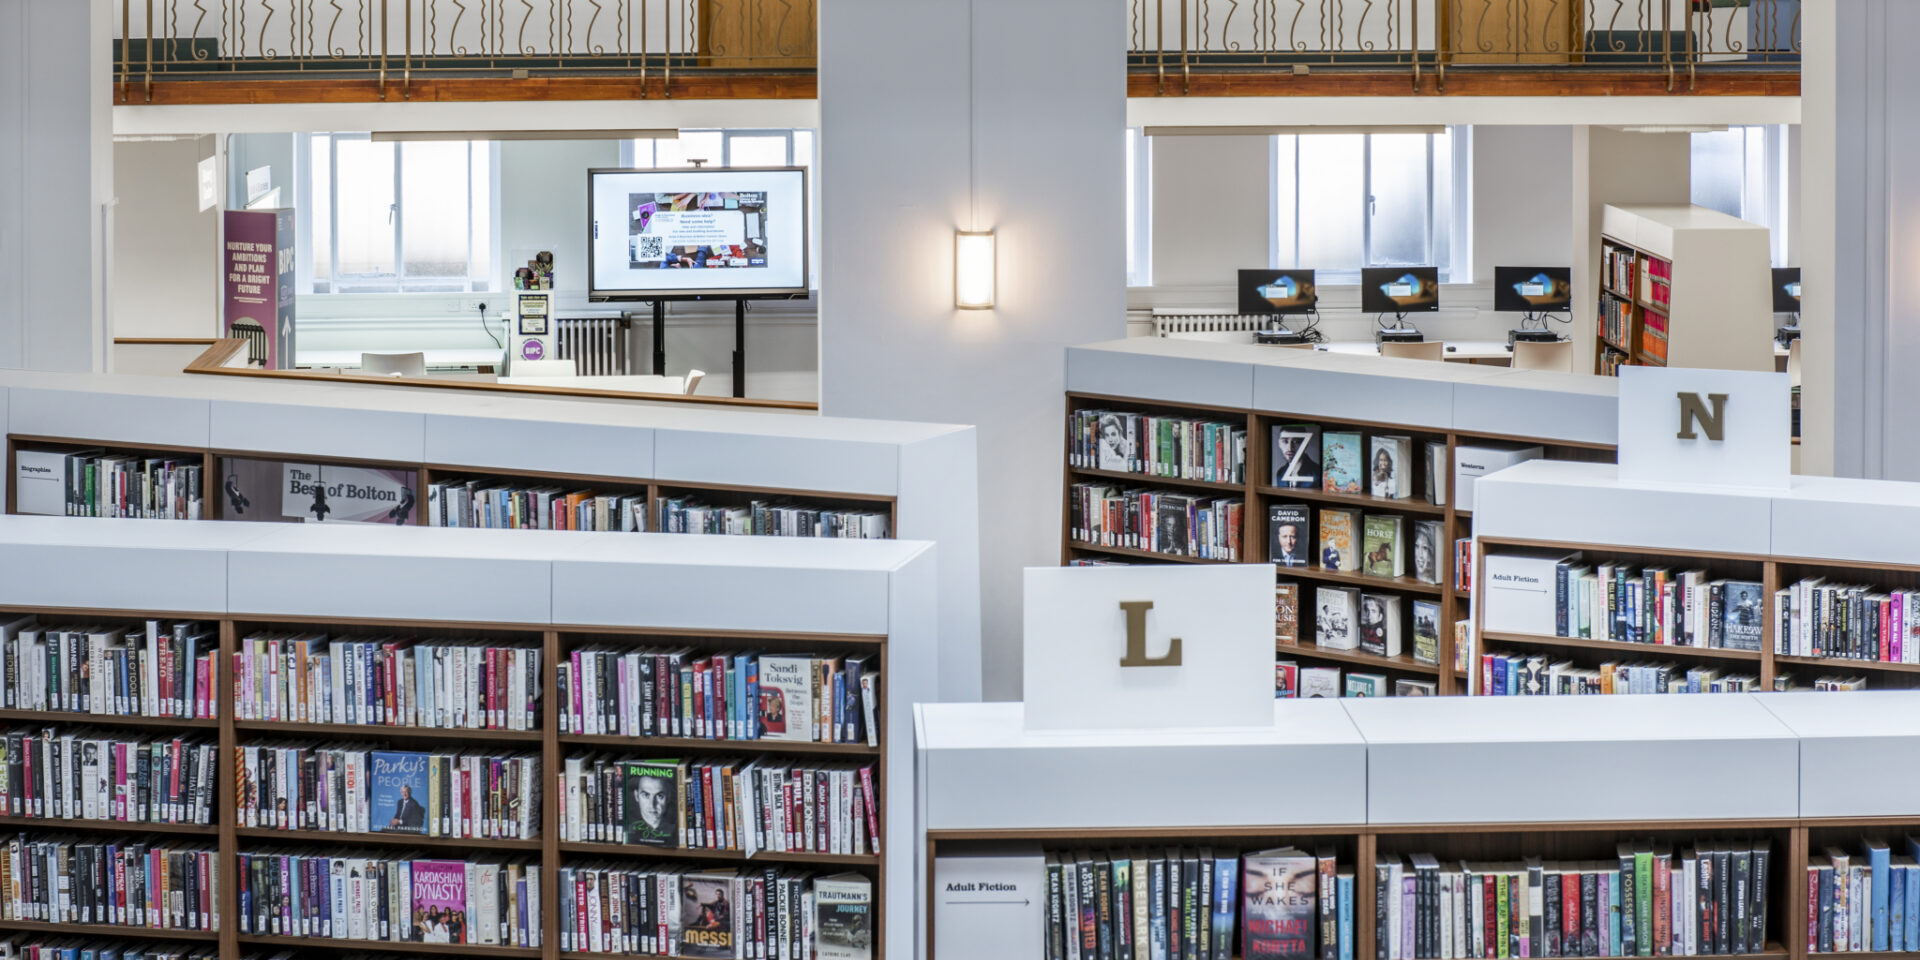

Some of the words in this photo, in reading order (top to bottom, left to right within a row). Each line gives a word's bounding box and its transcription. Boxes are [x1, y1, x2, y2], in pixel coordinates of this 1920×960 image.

[227, 242, 254, 252] NURTURE
[256, 243, 272, 253] YOUR
[232, 252, 266, 263] AMBITIONS
[278, 248, 294, 276] BIPC
[234, 263, 247, 274] AND
[248, 263, 264, 274] PLAN
[229, 273, 240, 284] FOR
[241, 274, 246, 284] A
[248, 274, 270, 285] BRIGHT
[238, 284, 261, 294] FUTURE
[525, 347, 540, 355] BIPC
[1676, 392, 1728, 440] N
[20, 464, 51, 474] Biographies
[290, 469, 312, 480] The
[290, 480, 325, 499] Bes
[328, 484, 344, 496] of
[346, 484, 396, 502] Bolton
[1366, 528, 1394, 539] HORSE
[1492, 573, 1512, 582] Adult
[1514, 575, 1540, 584] Fiction
[1120, 601, 1182, 667] L
[1726, 622, 1762, 634] HARROW
[288, 657, 295, 670] CJ
[770, 662, 798, 674] Sandi
[129, 662, 137, 697] O'TOOLE
[764, 673, 803, 686] Toksvig
[373, 756, 426, 778] Parky's
[630, 766, 673, 778] RUNNING
[378, 776, 421, 788] PEOPLE
[773, 773, 781, 792] BITING
[804, 773, 812, 802] EDDIE
[805, 803, 813, 835] JONES
[270, 858, 280, 884] JADE
[1273, 868, 1287, 876] IF
[1700, 859, 1710, 889] Leather
[414, 872, 463, 884] KARDASHIAN
[611, 874, 620, 895] WILLIE
[1136, 866, 1146, 898] RISE
[414, 884, 462, 901] DYNASTY
[946, 882, 975, 892] Adult
[976, 882, 1018, 892] Fiction
[1264, 882, 1295, 891] SHE
[819, 891, 868, 901] TRAUTMANN'S
[1251, 896, 1309, 906] WAKES
[588, 894, 598, 924] JONNY
[612, 897, 621, 914] JOHN
[836, 904, 867, 914] JOURNEY
[1084, 909, 1096, 949] DEVOTED
[1136, 907, 1146, 945] DARK
[1248, 920, 1307, 935] MICHAEL
[1252, 939, 1306, 955] KORYTA
